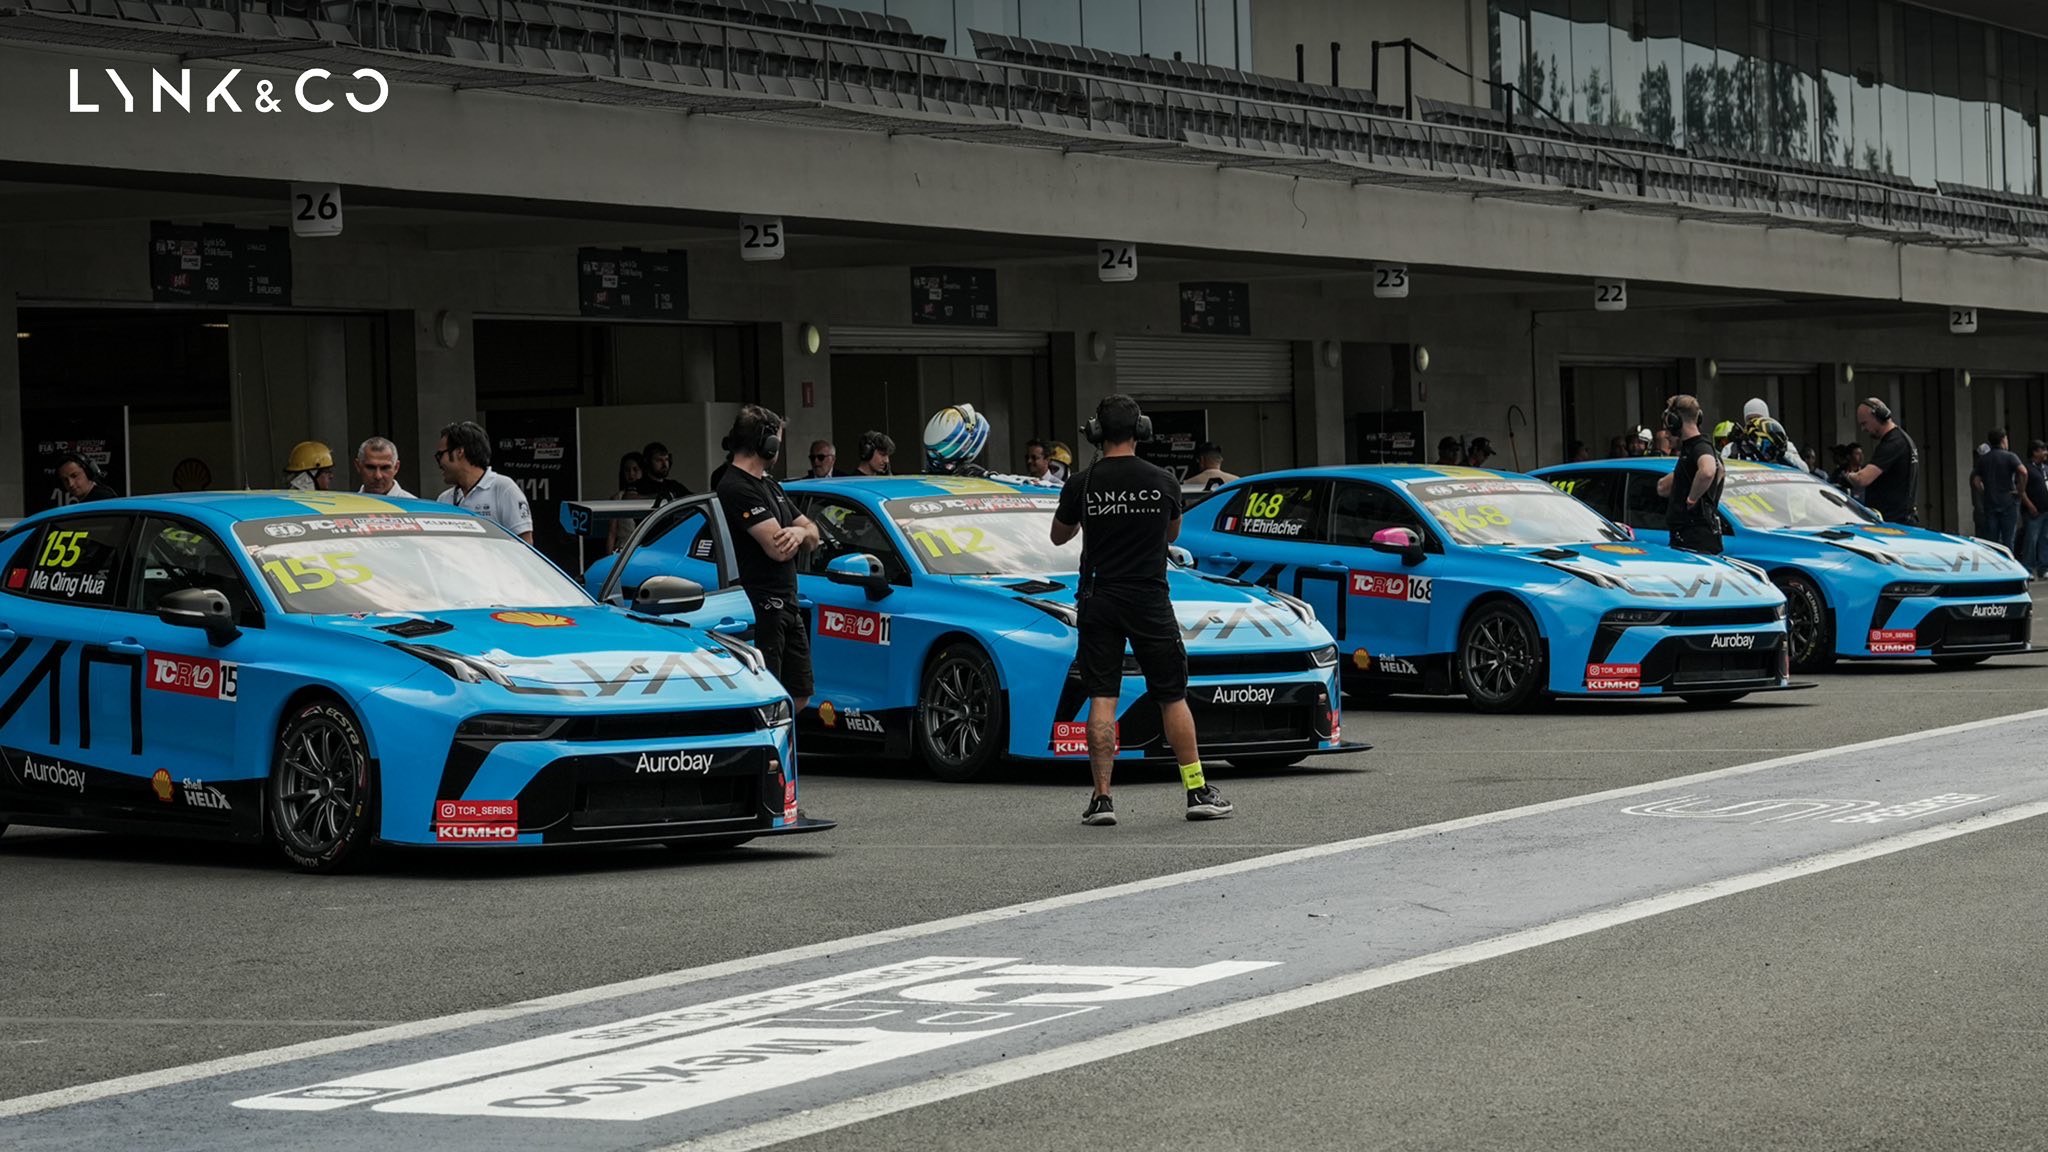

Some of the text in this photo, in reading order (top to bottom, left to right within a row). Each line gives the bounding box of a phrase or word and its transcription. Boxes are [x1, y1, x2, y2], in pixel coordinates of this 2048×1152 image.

[296, 193, 338, 220] 26
[744, 224, 779, 248] 25
[1101, 248, 1132, 269] 24
[1376, 269, 1405, 287] 23
[1597, 285, 1623, 302] 22
[1952, 311, 1974, 325] 21
[1245, 492, 1284, 518] 168
[1727, 492, 1776, 517] 111
[266, 518, 355, 537] FIA TCR
[1243, 518, 1303, 536] Y.Ehrlacher
[1440, 505, 1512, 533] 168
[38, 530, 89, 568] 155
[912, 527, 995, 558] 112
[262, 551, 374, 594] 155
[30, 570, 105, 598] Ma Qing Hua
[1409, 578, 1432, 601] 168
[1805, 590, 1820, 624] KUMHO
[1972, 604, 2007, 618] Aurobay
[1711, 634, 1755, 649] Aurobay
[1871, 644, 1915, 652] KUMHO
[1380, 660, 1419, 675] HELIX
[1601, 667, 1638, 675] TCR_SERIES
[1212, 685, 1275, 705] Aurobay
[1588, 681, 1639, 689] KUMHO
[844, 707, 861, 717] Shell
[845, 716, 885, 733] HELIX
[635, 750, 714, 774] Aurobay
[24, 755, 86, 793] Aurobay
[183, 778, 202, 790] Shell
[185, 788, 232, 810] HELIX
[457, 806, 513, 817] TCR_SERIES
[439, 827, 516, 838] KUMHO
[285, 845, 320, 867] KUMHO
[570, 960, 974, 1040] TOURING CAR CLASS
[489, 1038, 869, 1109] Mexico
